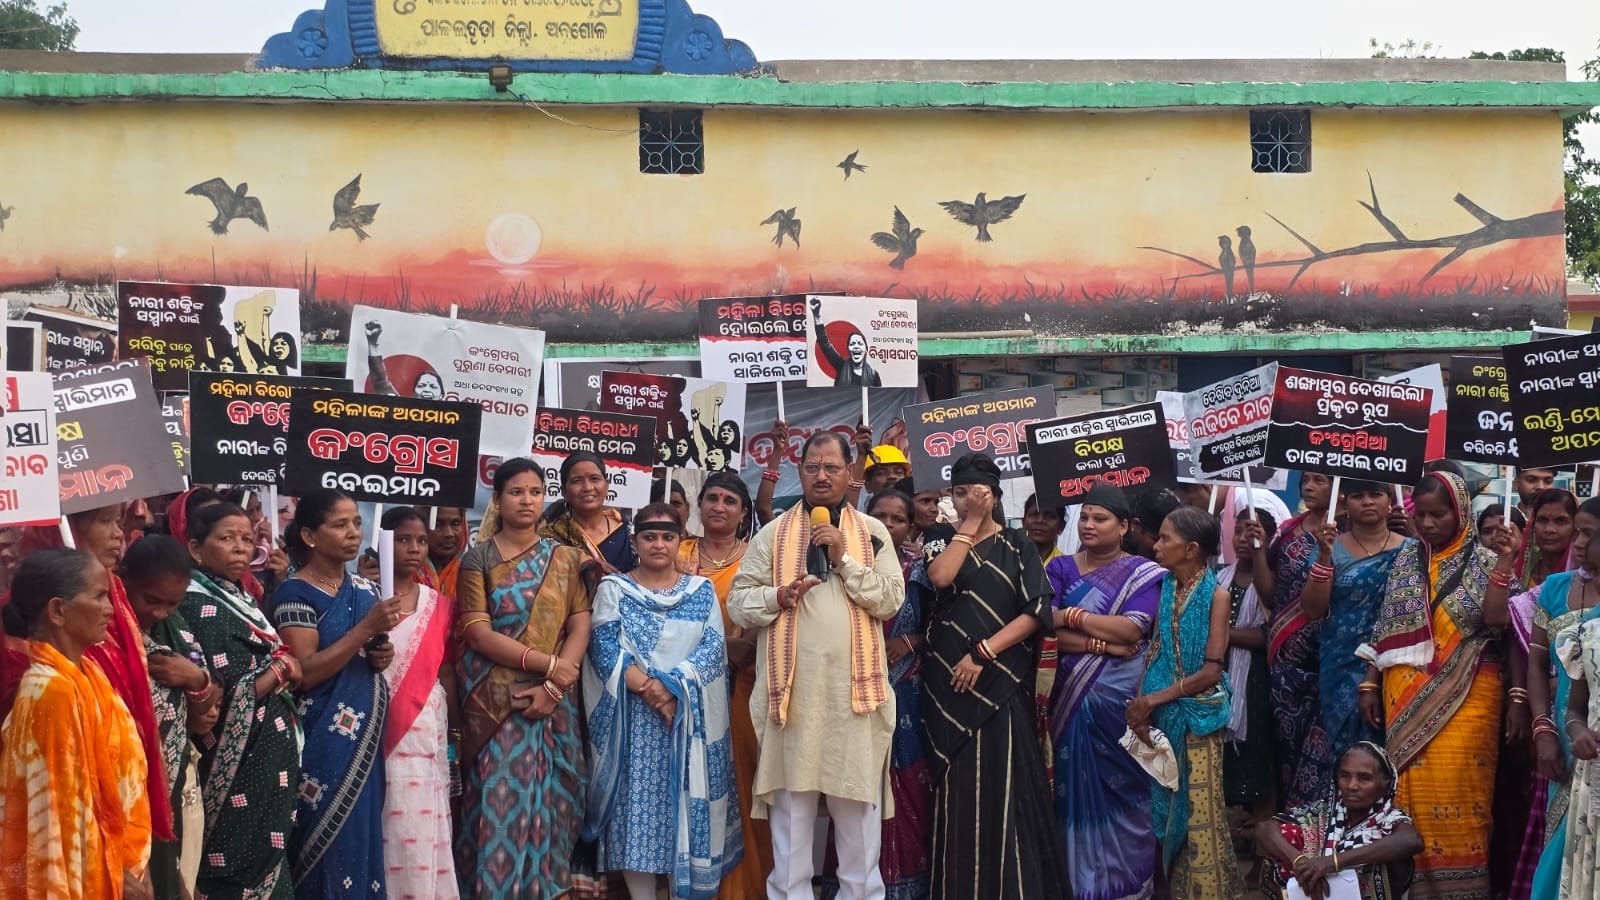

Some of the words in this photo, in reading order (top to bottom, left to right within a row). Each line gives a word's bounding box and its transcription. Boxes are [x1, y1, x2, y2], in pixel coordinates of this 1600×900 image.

[129, 297, 164, 309] ନାରୀ
[717, 302, 764, 320] ମହିଳା
[137, 311, 176, 327] ସମ୍ମାନ
[178, 314, 200, 324] ପାଇଁ
[720, 320, 790, 337] ହୋଇଲେ
[129, 336, 166, 354] ମରିବୁ
[469, 346, 520, 362] କଂଗ୍ରେସର
[729, 351, 763, 363] ନାରୀ
[766, 347, 793, 365] ଶକ୍ତି
[1524, 349, 1580, 366] ନାରୀଙ୍କ
[734, 365, 786, 379] ସାଜିଲେ
[210, 380, 252, 398] ମହିଳା
[609, 384, 637, 395] ନାରୀ
[1349, 381, 1424, 401] ଦେଖାଇଲା
[1456, 384, 1486, 397] ନାରୀ
[1519, 376, 1575, 393] ନାରୀଙ୍କ
[614, 395, 646, 410] ସମ୍ମାନ
[921, 403, 980, 423] ମହିଳାଙ୍କ
[983, 396, 1037, 413] ଅପମାନ
[1317, 398, 1358, 418] ପ୍ରକୃତ
[313, 399, 389, 418] ମହିଳାଙ୍କ
[393, 407, 460, 425] ଅପମାନ
[535, 412, 573, 433] ହିଳା
[576, 415, 639, 438] ବିରୋଧୀ
[1038, 427, 1068, 440] ନାରୀ
[217, 440, 270, 456] ନାରୀଙ୍କ
[307, 428, 461, 475] କଂଗ୍ରେସ
[598, 439, 636, 455] ମେଳ
[1074, 437, 1124, 457] ବିପକ୍ଷ
[1285, 448, 1324, 465] ତାଙ୍କ
[1326, 451, 1371, 470] ଅସଲ
[1374, 456, 1407, 473] ବାପ
[321, 472, 440, 497] ବେଇମାନ
